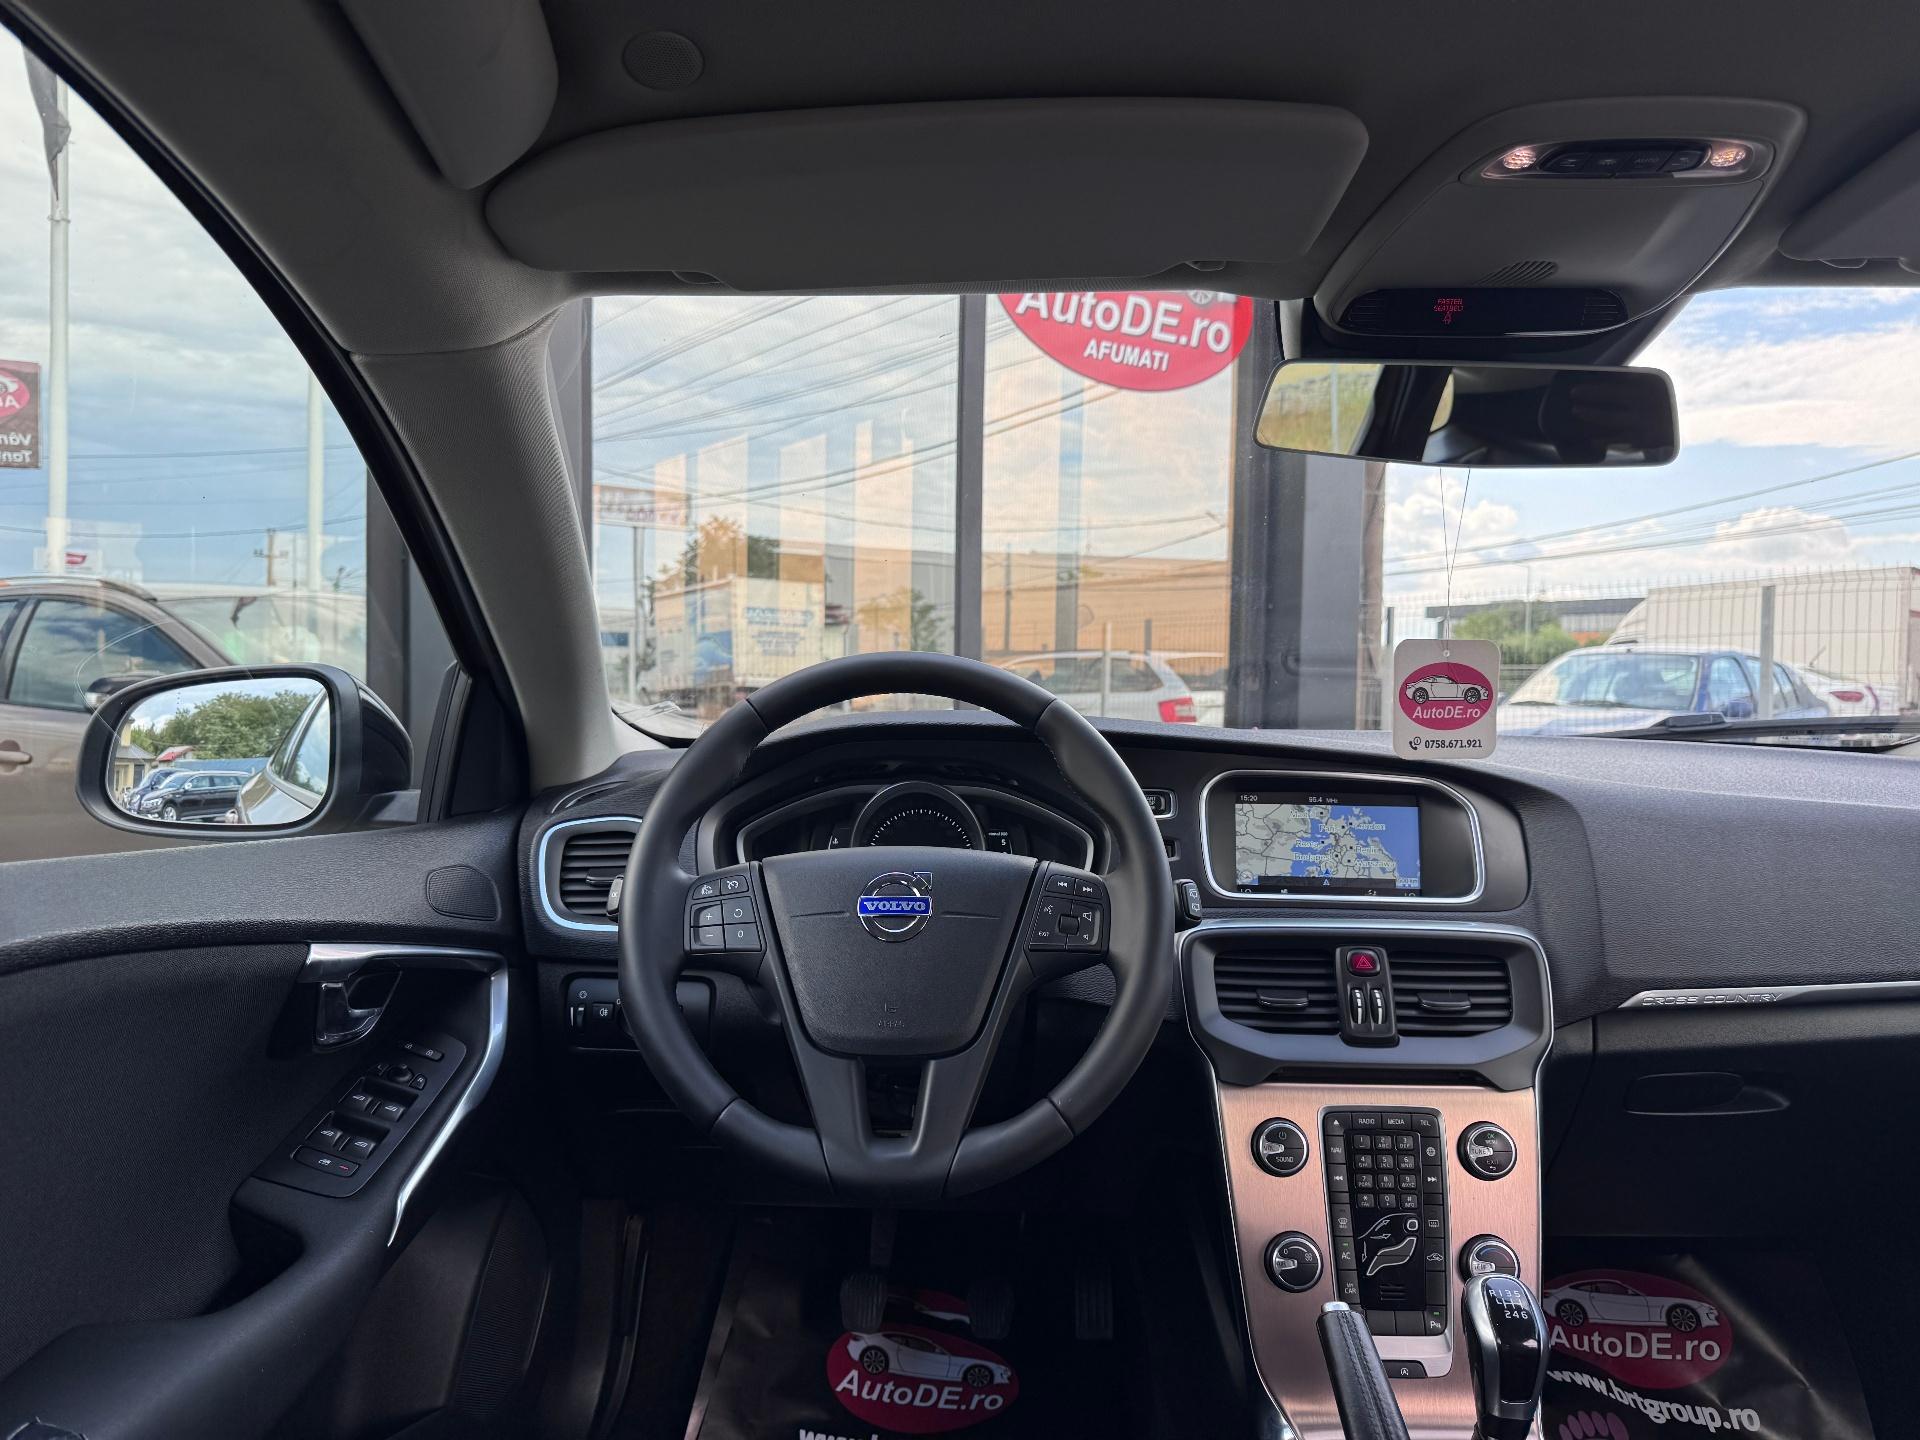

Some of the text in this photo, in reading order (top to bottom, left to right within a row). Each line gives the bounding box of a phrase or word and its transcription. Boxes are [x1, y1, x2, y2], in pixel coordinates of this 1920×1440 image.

[1016, 292, 1232, 352] AutoDE.ro
[1084, 339, 1169, 372] AFUMATI
[1412, 706, 1480, 719] AutoDE.ro
[1424, 739, 1482, 749] 0758.671.921
[864, 901, 926, 911] VOLVO
[1642, 992, 1784, 1006] CROSS COUNTRY
[1341, 1252, 1351, 1260] AC
[1488, 1289, 1496, 1297] R
[1513, 1290, 1521, 1298] 5
[1504, 1310, 1528, 1319] 2 4 6
[1549, 1324, 1721, 1362] AutoDE.ro
[835, 1369, 1004, 1410] AutoDE.ro
[1547, 1370, 1761, 1433] www.brtgroup.ro
